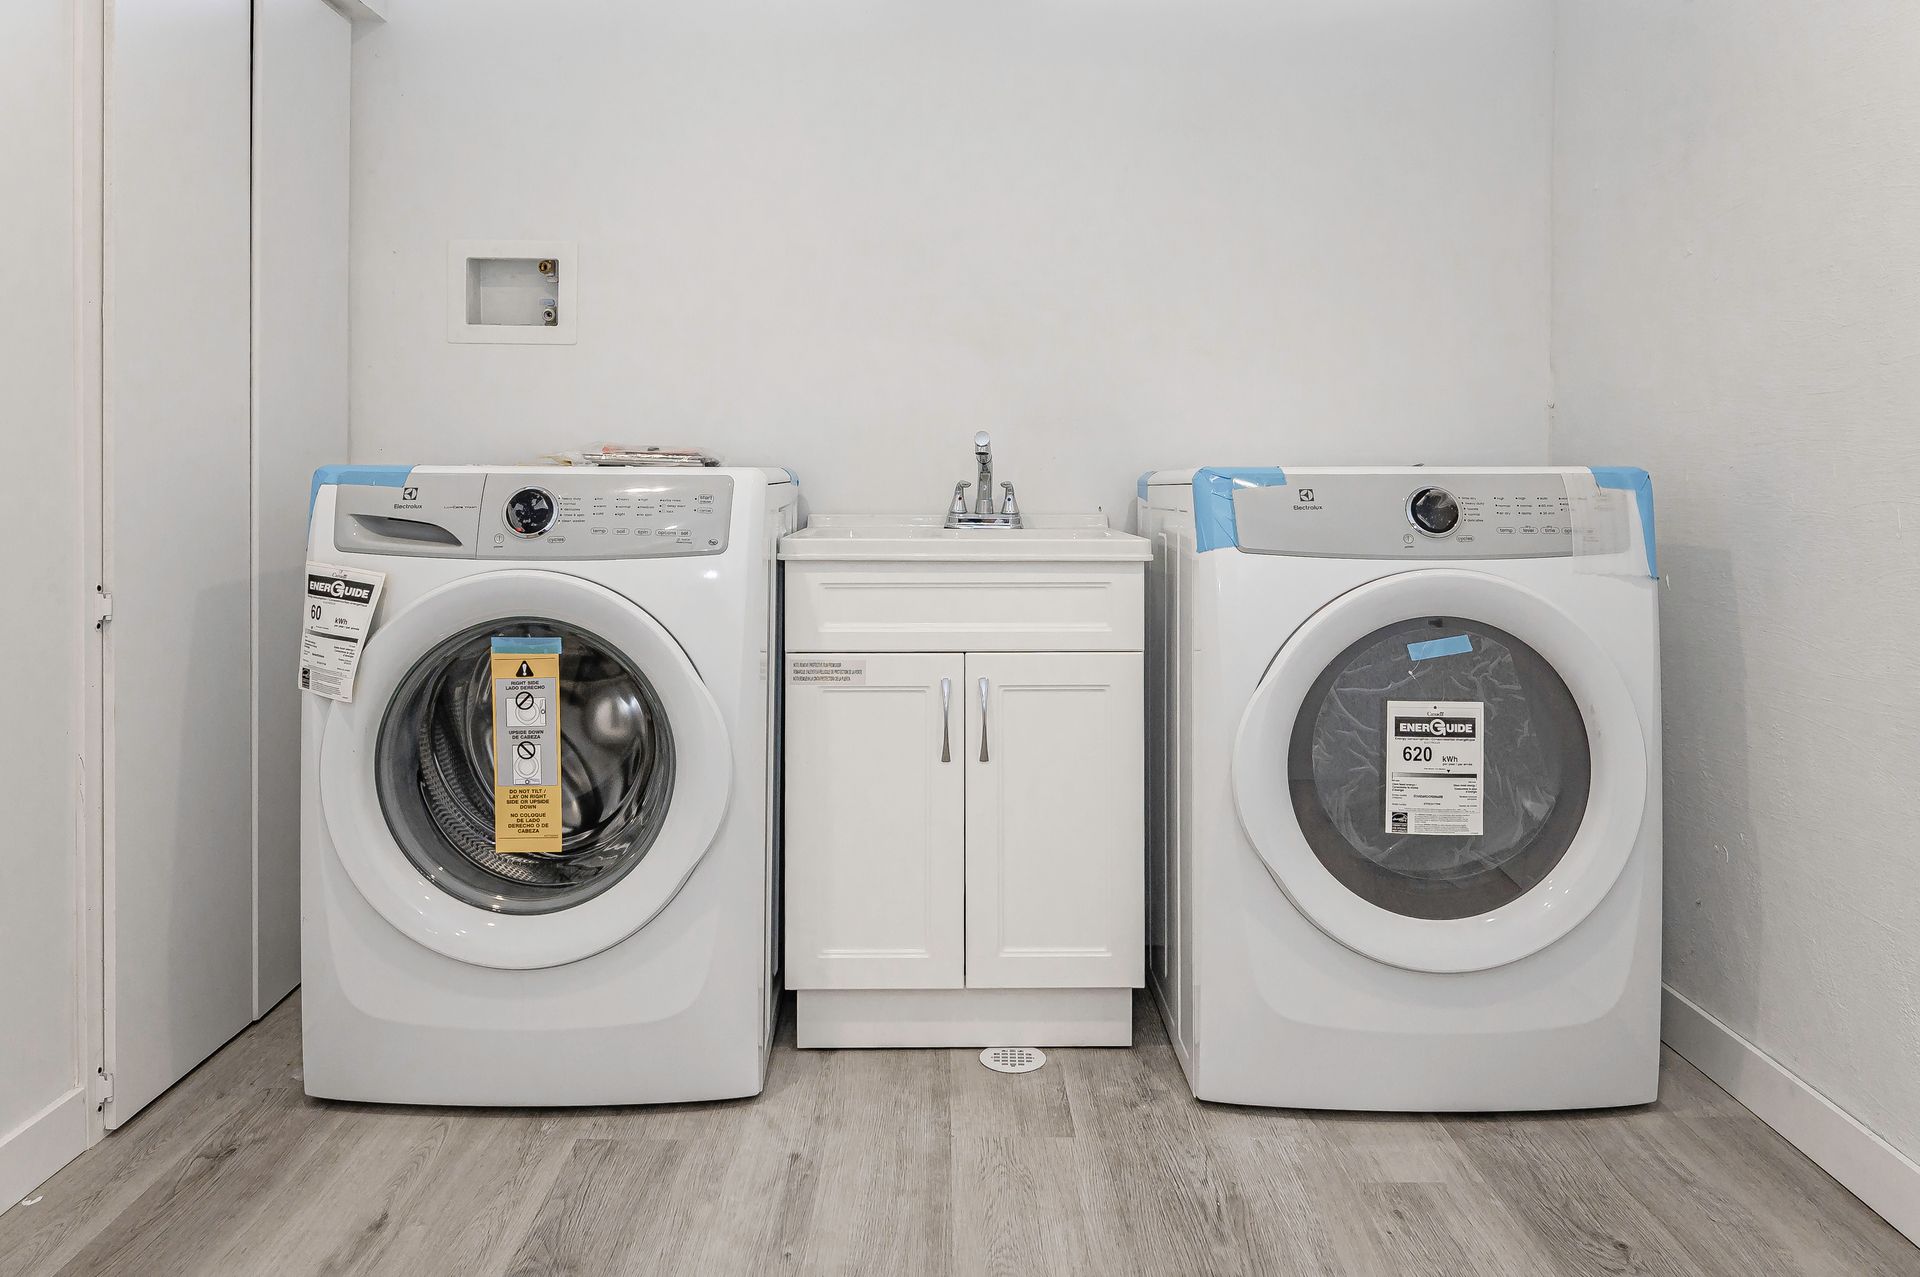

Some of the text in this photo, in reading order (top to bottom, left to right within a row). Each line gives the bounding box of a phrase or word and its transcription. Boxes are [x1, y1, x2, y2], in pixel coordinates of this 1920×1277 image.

[309, 580, 370, 599] ENERGUIDE
[310, 604, 322, 620] 60
[335, 617, 348, 625] kWh
[1399, 718, 1473, 736] ENERGUIDE
[1402, 746, 1433, 762] 620
[1442, 755, 1458, 763] kWh
